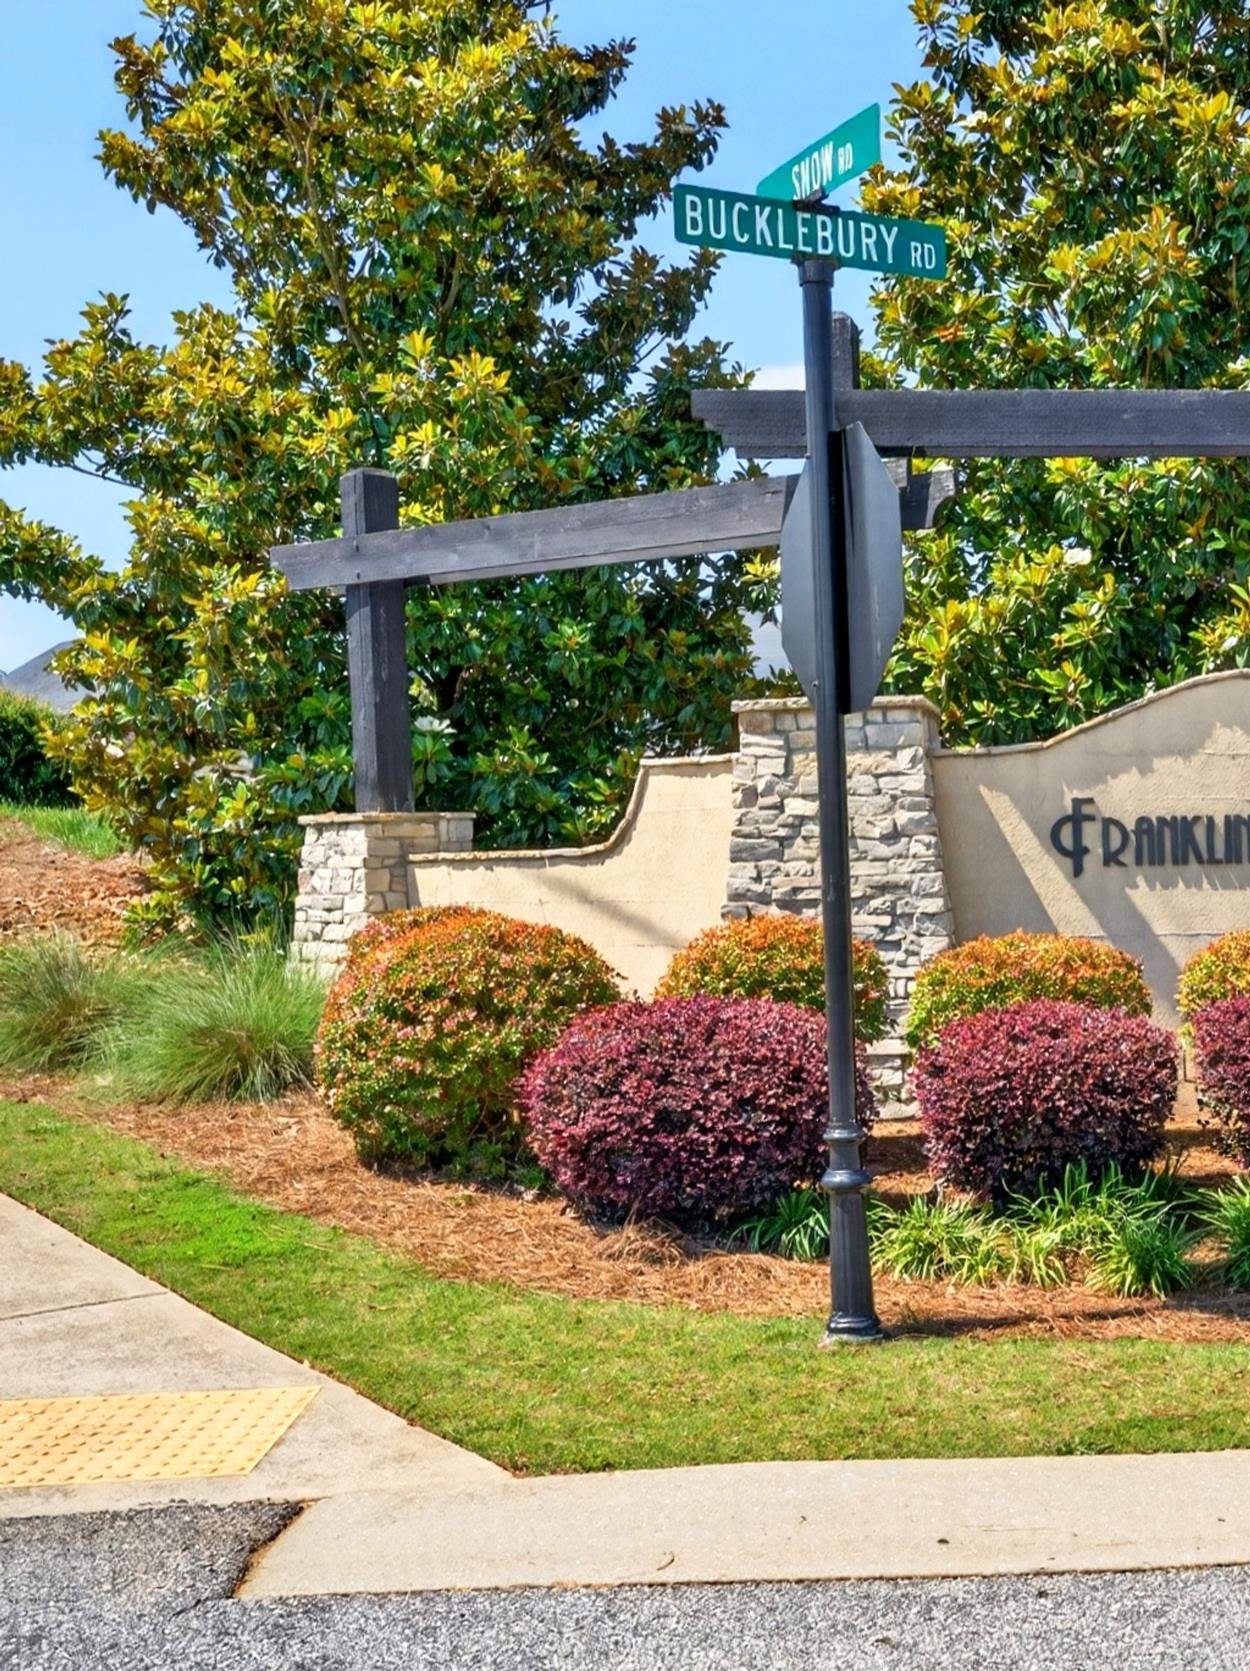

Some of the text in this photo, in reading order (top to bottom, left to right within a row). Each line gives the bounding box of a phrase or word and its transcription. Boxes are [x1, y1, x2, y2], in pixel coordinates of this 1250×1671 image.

[791, 141, 853, 200] SNOW RD
[685, 195, 936, 269] BUCKLEBURY RD
